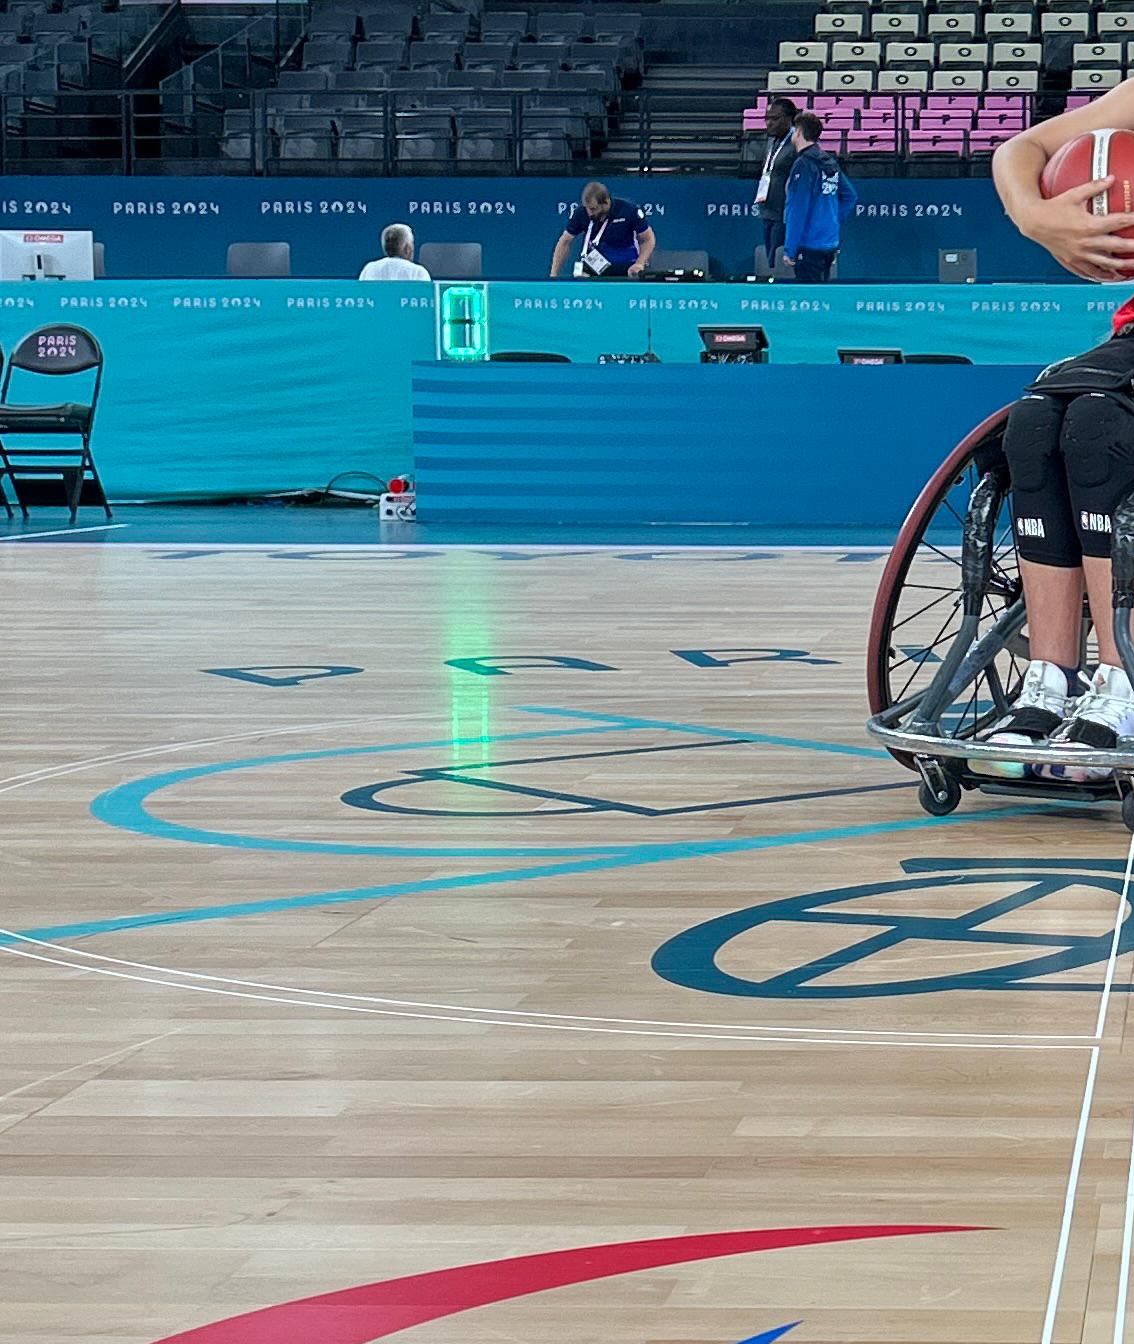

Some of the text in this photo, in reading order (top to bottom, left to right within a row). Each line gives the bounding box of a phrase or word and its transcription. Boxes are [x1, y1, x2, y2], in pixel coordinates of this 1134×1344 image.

[24, 201, 71, 214] 2024
[172, 202, 219, 215] 2024
[319, 201, 367, 214] 2024
[468, 201, 515, 214] 2024
[914, 204, 962, 217] 2024
[109, 297, 147, 308] 2024
[222, 297, 261, 308] 2024
[335, 297, 374, 308] 2024
[563, 299, 602, 310] 2024
[679, 299, 718, 310] 2024
[791, 300, 830, 312] 2024
[905, 301, 944, 312] 2024
[1021, 301, 1060, 312] 2024
[38, 346, 76, 357] 2024
[1023, 517, 1045, 539] NBA
[1089, 512, 1112, 534] NBA
